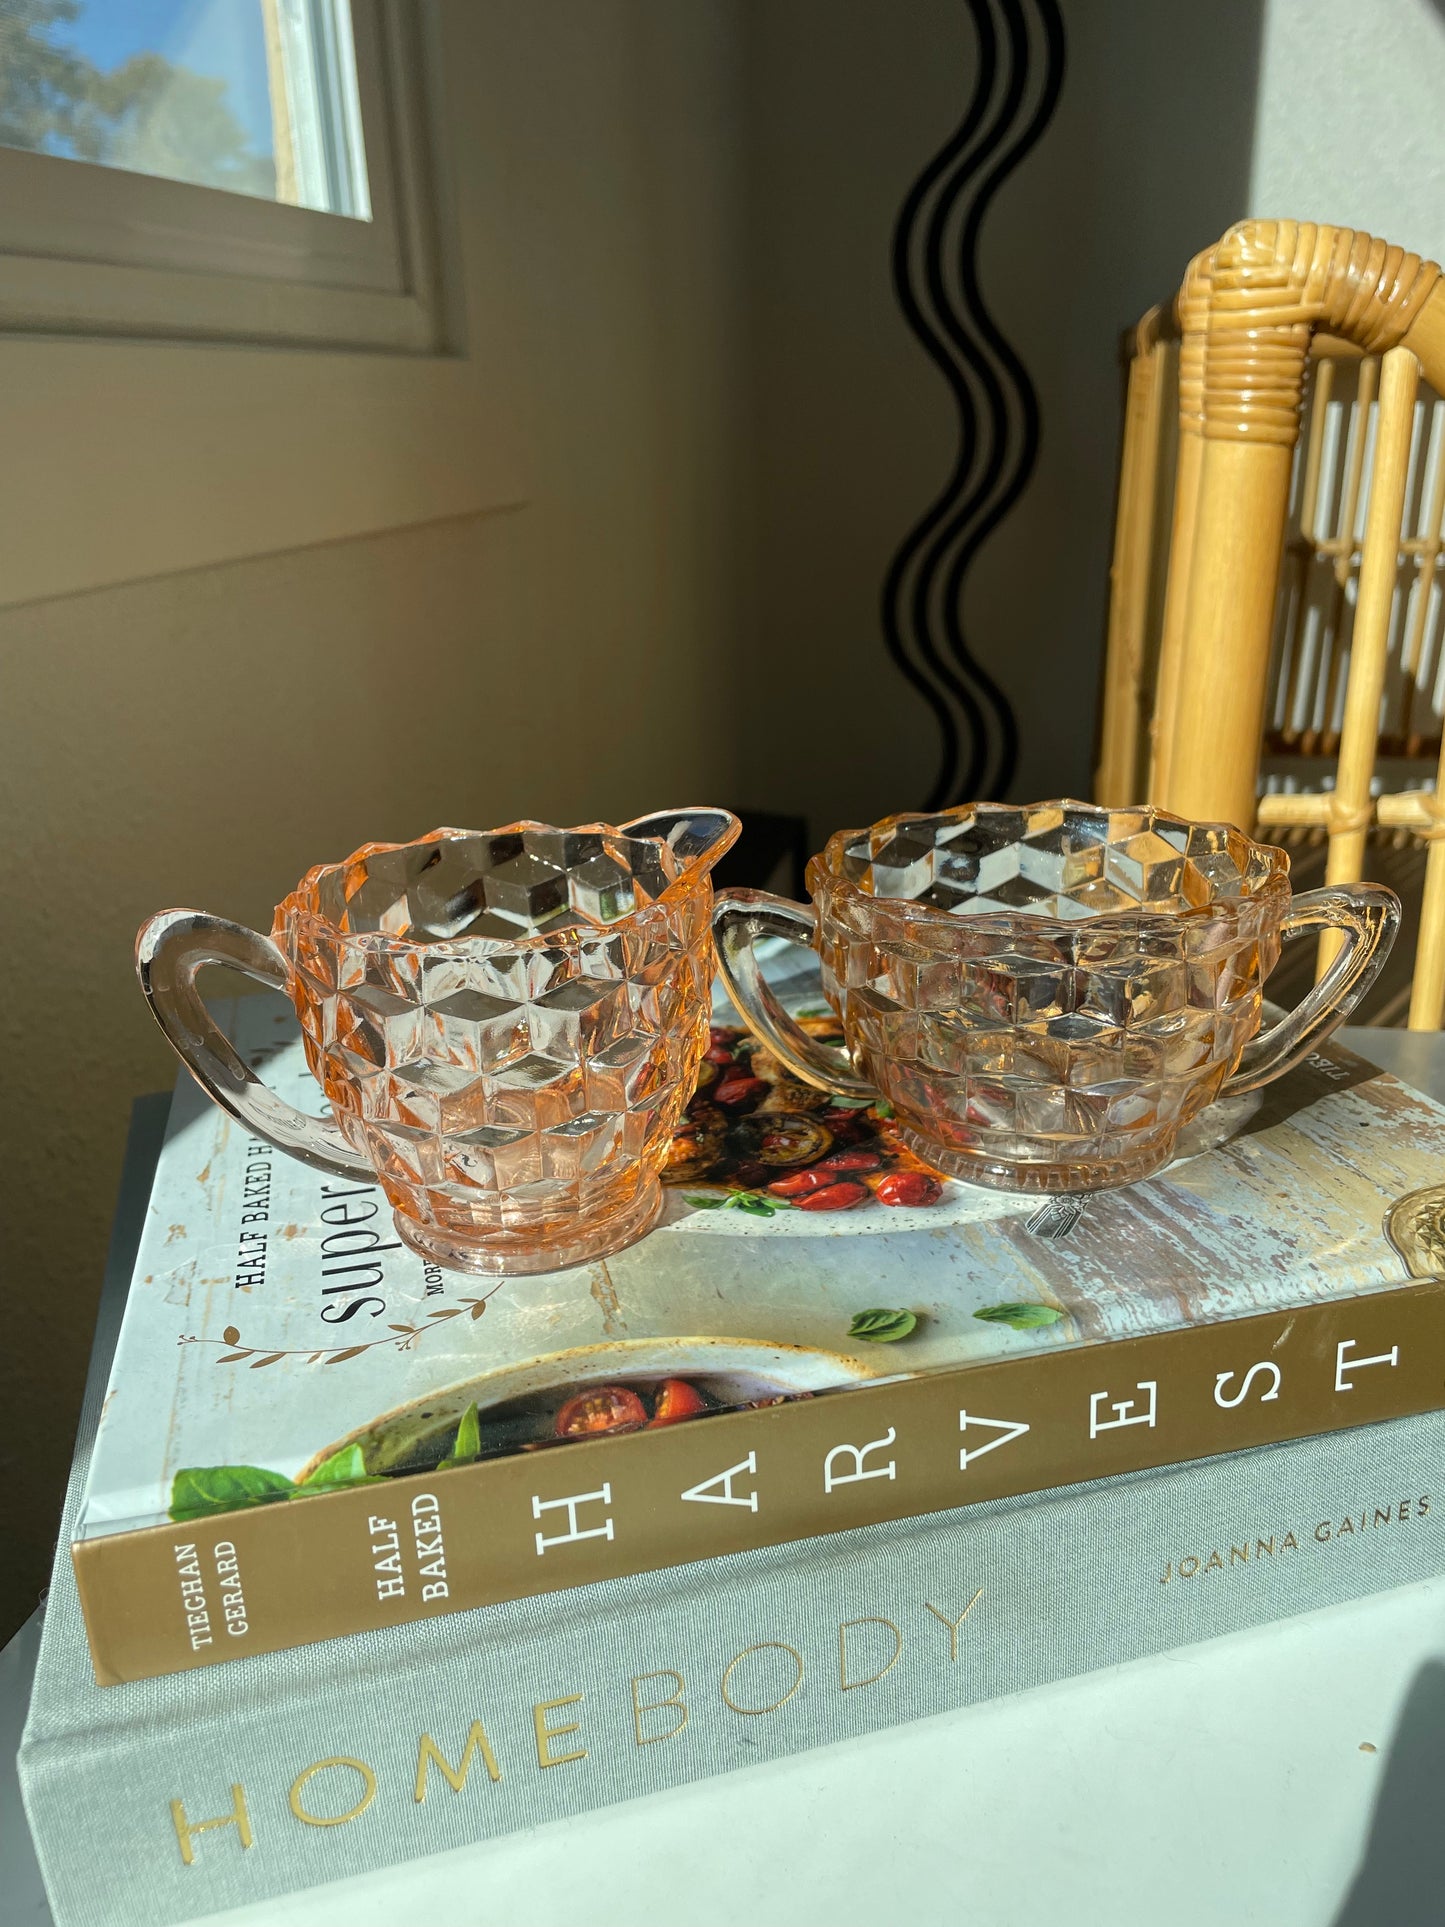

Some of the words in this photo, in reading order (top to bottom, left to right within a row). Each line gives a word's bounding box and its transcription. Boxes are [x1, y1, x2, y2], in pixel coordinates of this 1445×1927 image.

[241, 1161, 272, 1224] BAKED
[235, 1231, 267, 1288] HALF
[320, 1185, 402, 1323] super
[531, 1339, 1398, 1555] HARVEST
[214, 1540, 249, 1637] GERARD
[368, 1515, 405, 1601] HALF
[413, 1492, 449, 1602] BAKED
[1160, 1531, 1299, 1584] JOANNA
[1314, 1494, 1431, 1544] GAINES
[174, 1543, 213, 1651] TIEGHAN
[171, 1588, 984, 1866] HOMEBODY
